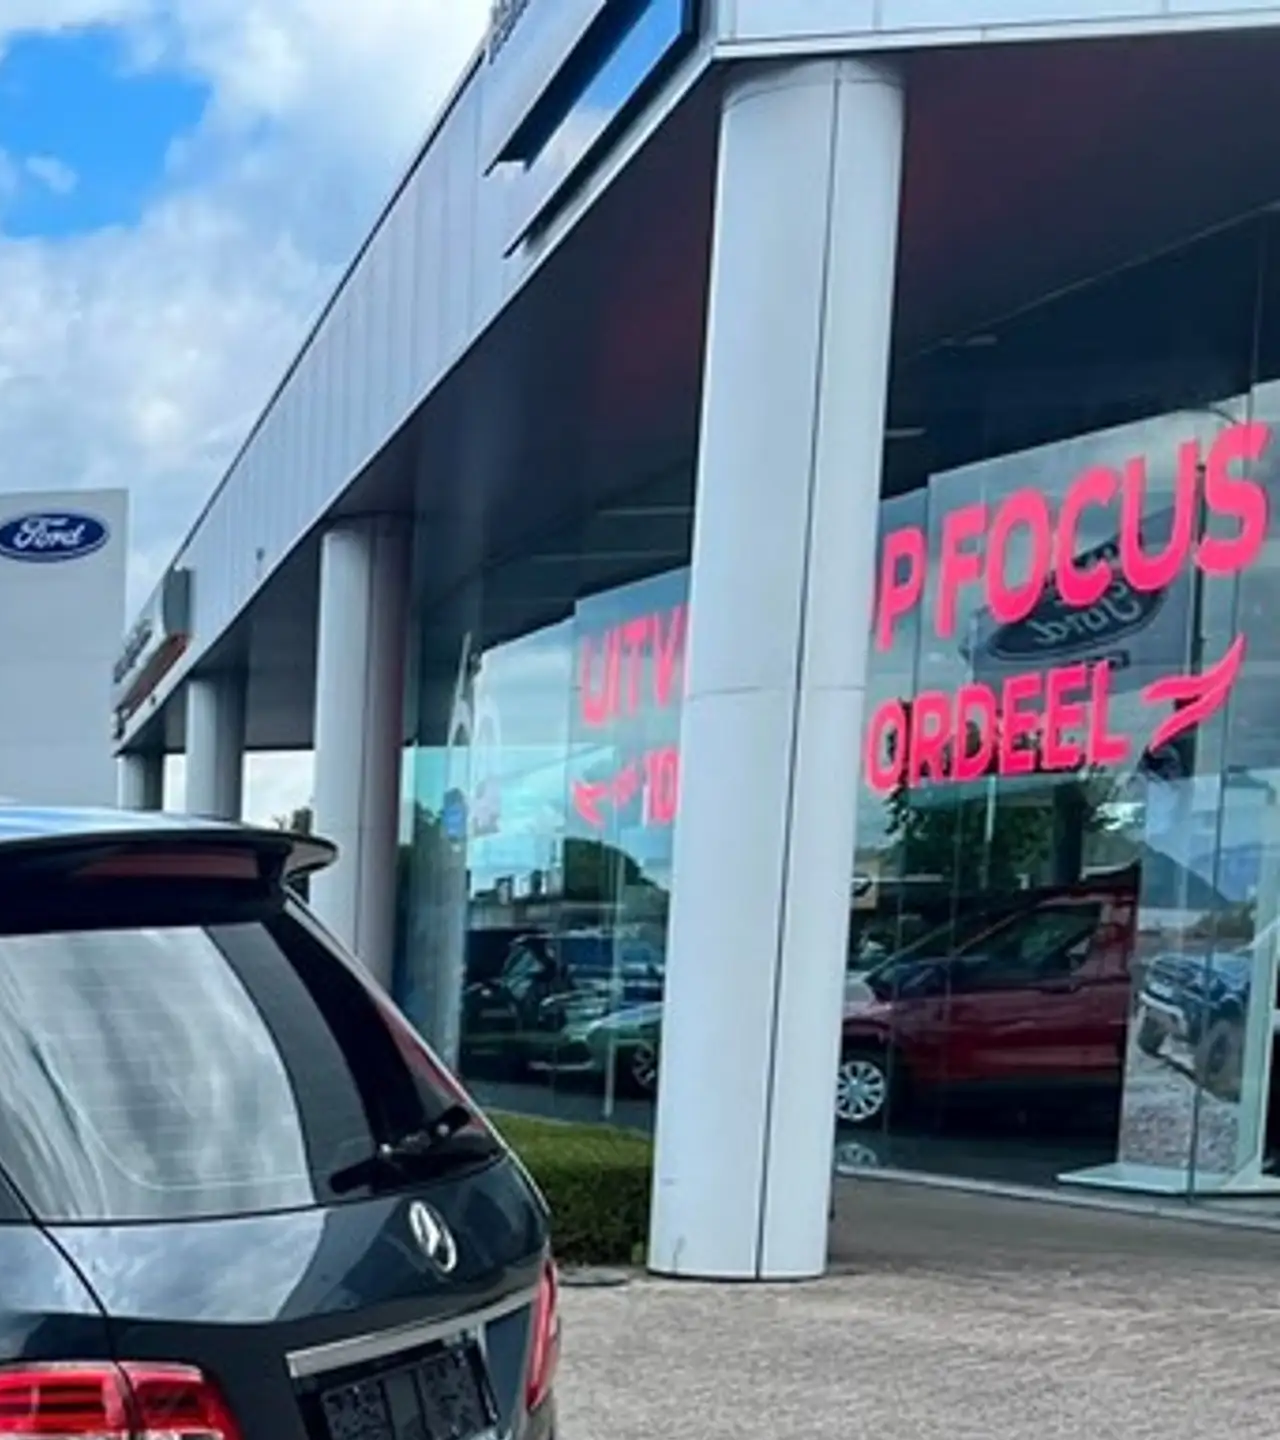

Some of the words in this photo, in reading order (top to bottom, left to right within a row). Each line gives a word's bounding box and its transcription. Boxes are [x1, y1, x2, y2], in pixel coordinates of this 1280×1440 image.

[13, 517, 85, 549] Ford
[874, 525, 927, 653] P
[934, 421, 1270, 639] FOCUS
[580, 606, 685, 724] UITV
[864, 659, 1132, 794] ORDEEL
